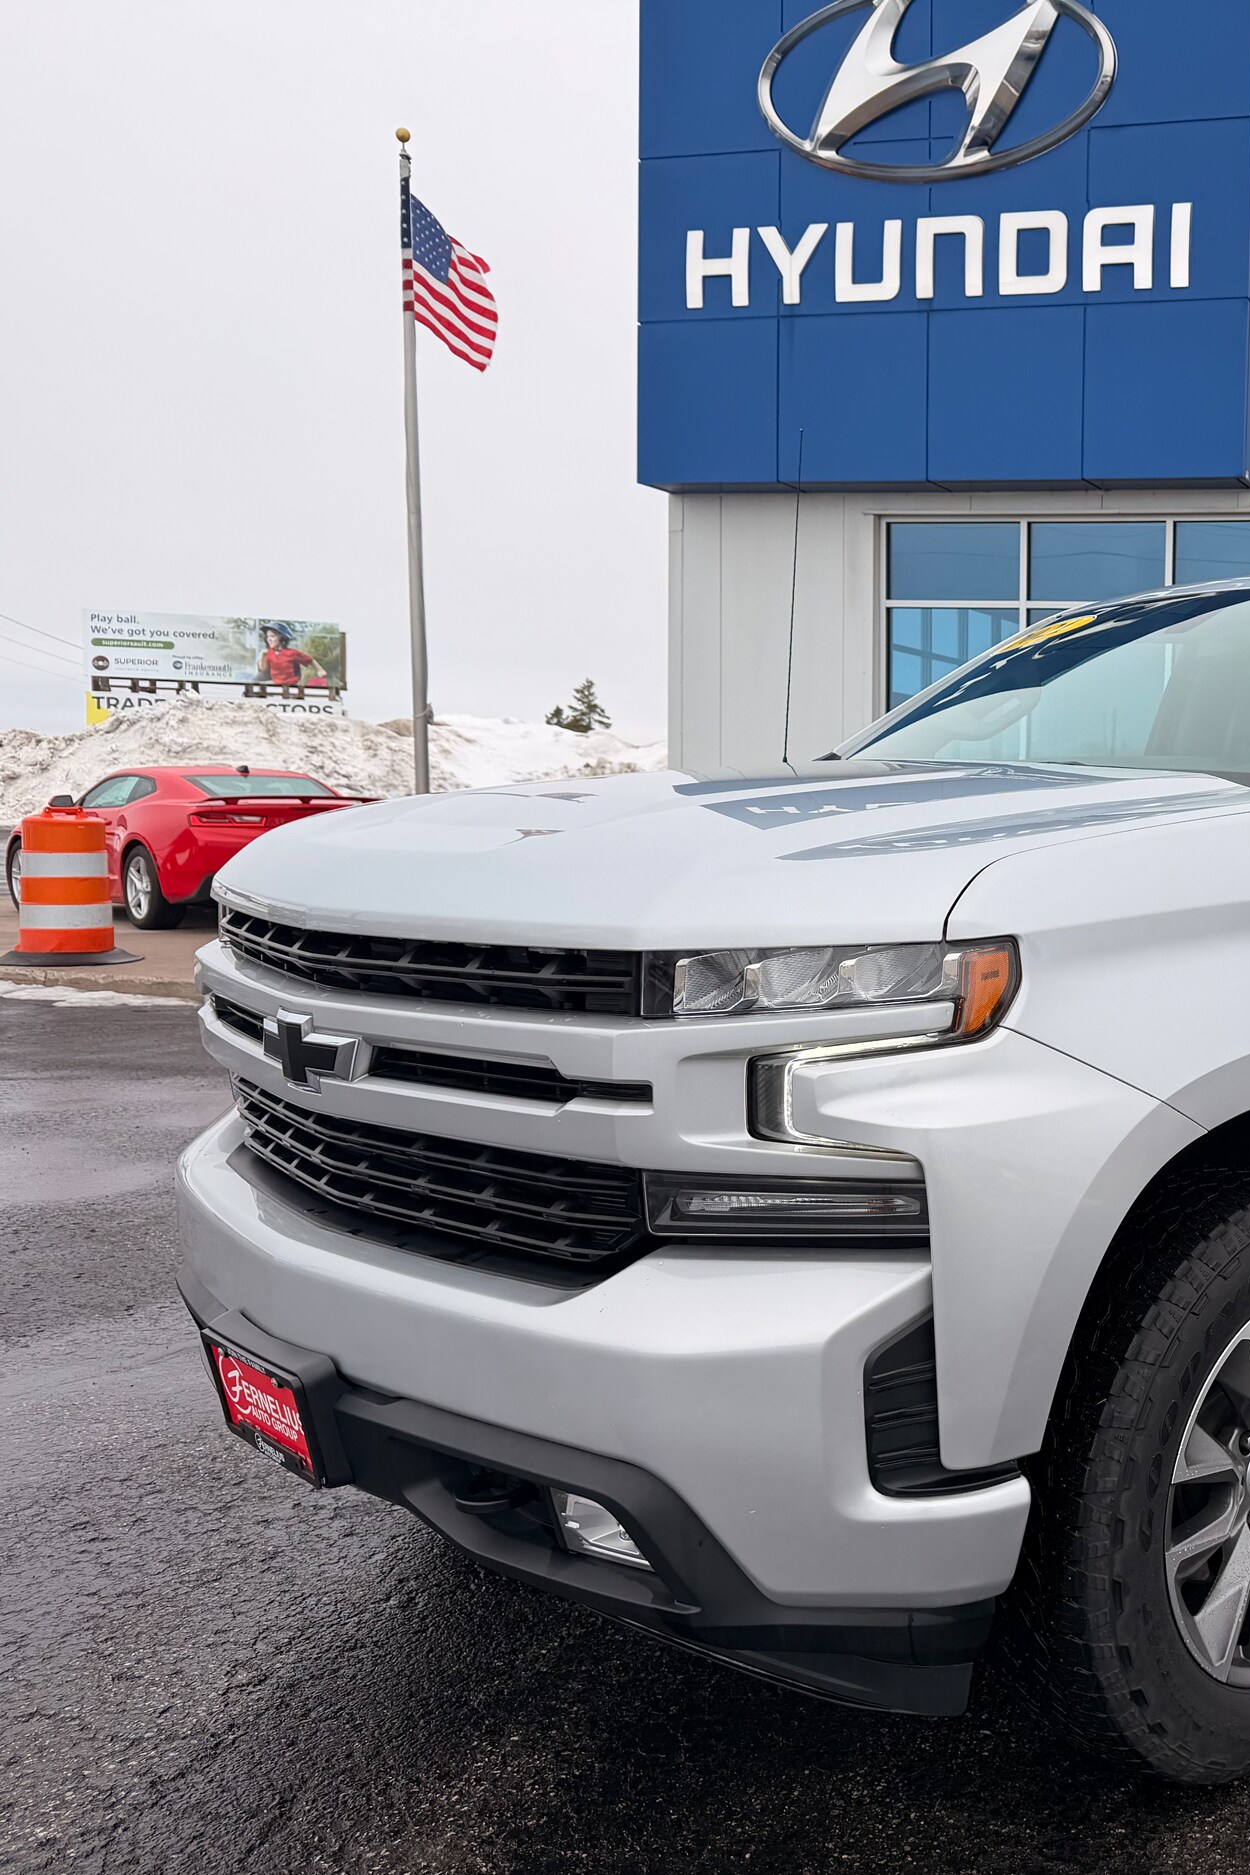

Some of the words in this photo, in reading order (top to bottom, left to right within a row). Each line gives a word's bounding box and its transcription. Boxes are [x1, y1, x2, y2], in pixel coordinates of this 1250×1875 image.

[685, 201, 1193, 310] HYUNDAI
[90, 613, 113, 624] Play
[116, 614, 140, 624] ball.
[90, 625, 124, 635] We've
[127, 628, 146, 637] got
[149, 628, 169, 638] you
[172, 629, 219, 640] covered.
[113, 657, 159, 667] SUPERIOR
[251, 1405, 271, 1426] AUTO
[271, 1416, 299, 1442] GROUP
